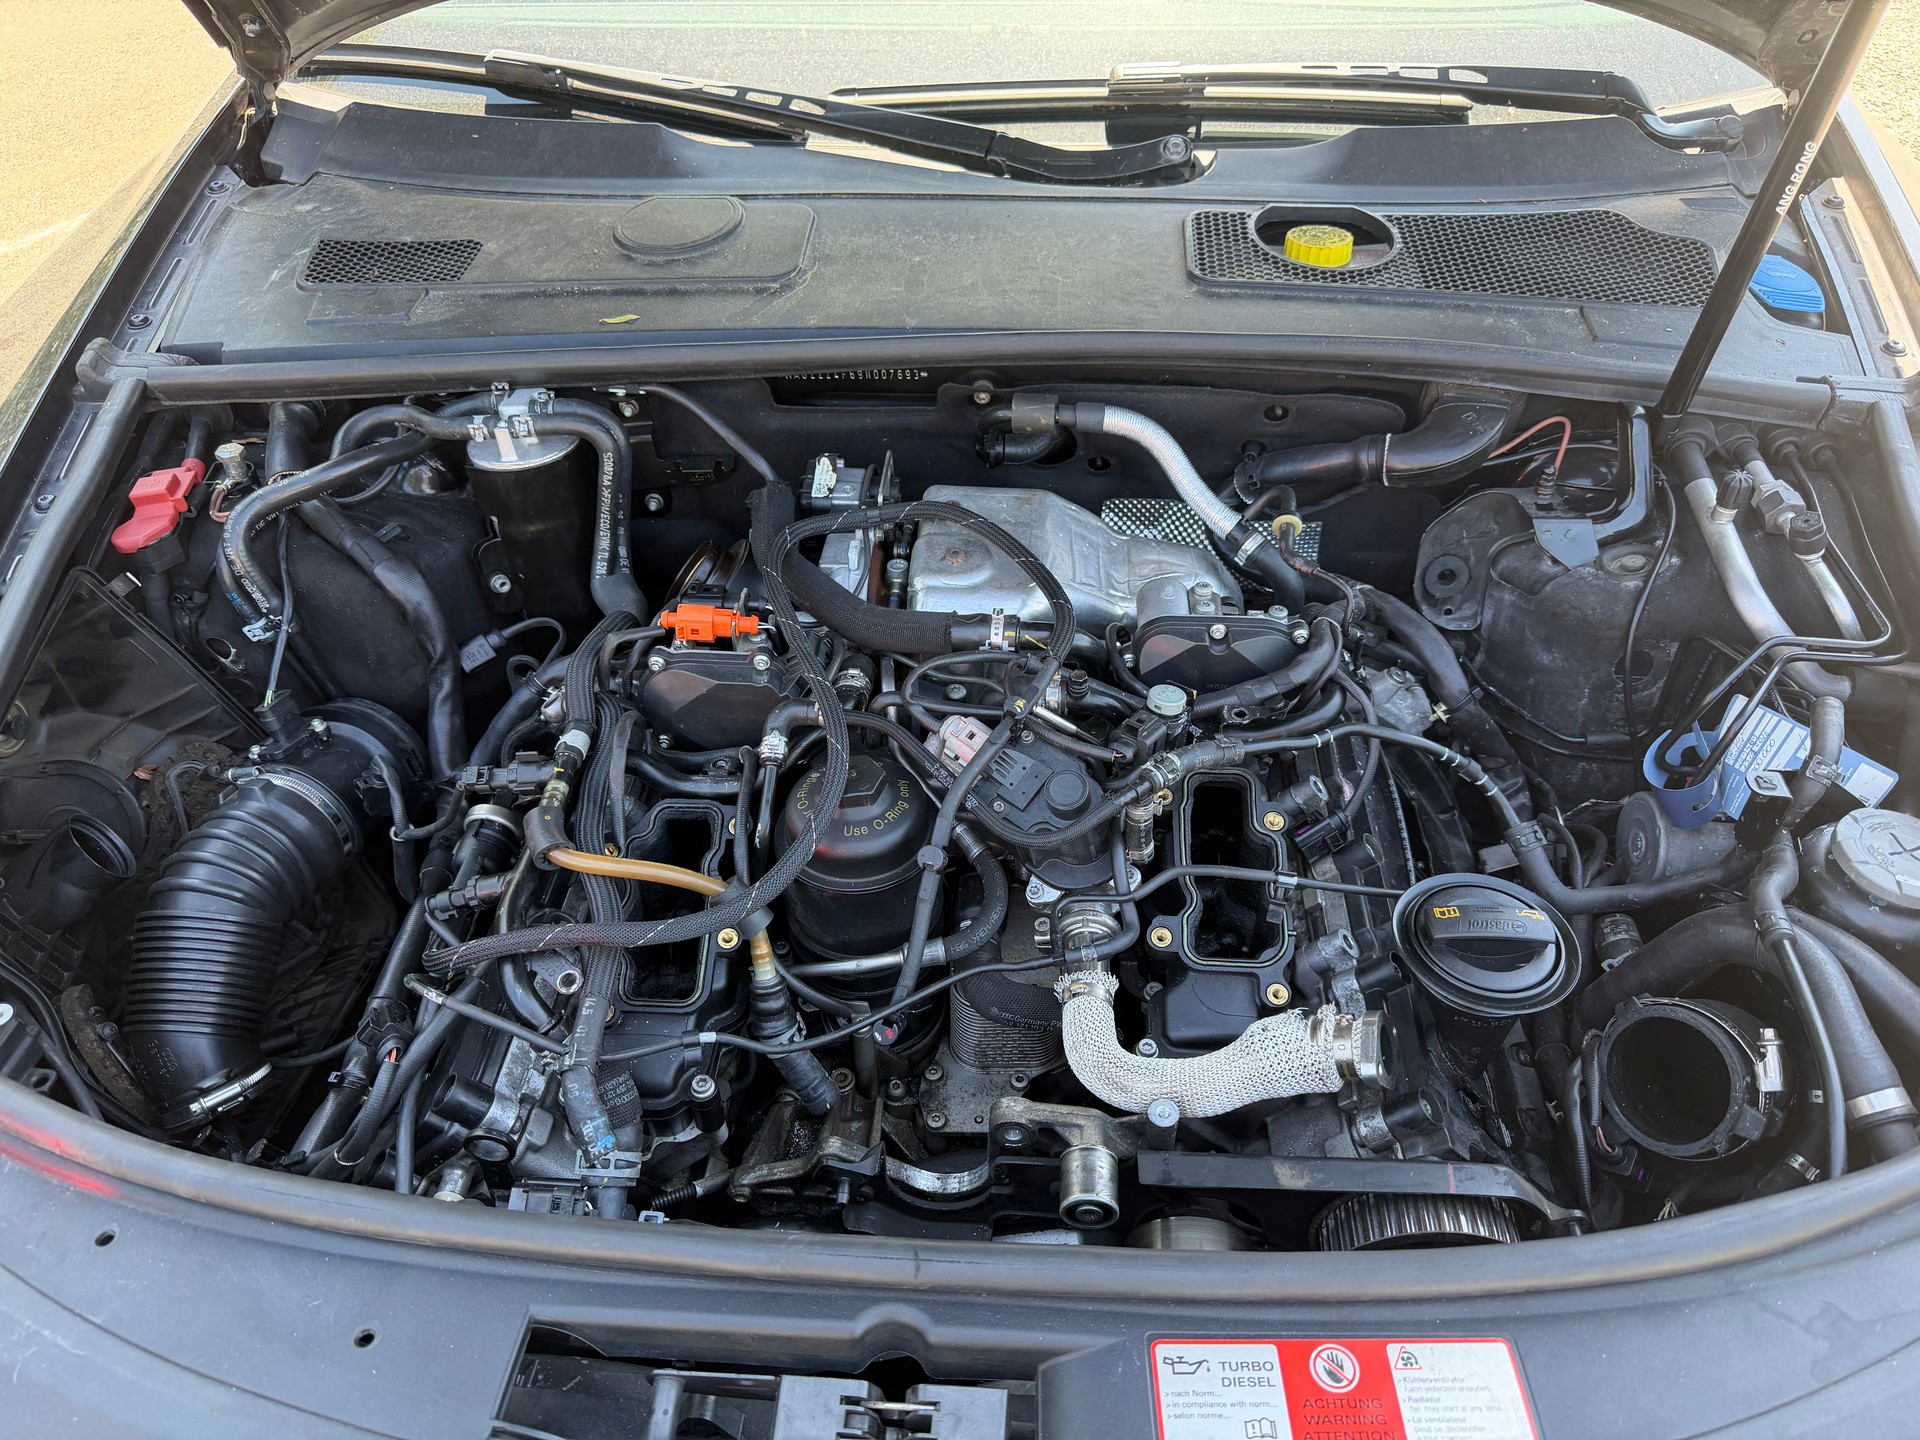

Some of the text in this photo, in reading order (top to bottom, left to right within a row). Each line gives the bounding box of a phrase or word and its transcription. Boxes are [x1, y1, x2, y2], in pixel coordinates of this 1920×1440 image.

[1790, 141, 1817, 183] RONG
[797, 772, 821, 810] O-Ringe
[843, 779, 910, 837] Use O-Ring only
[1467, 917, 1511, 931] Castrol
[1217, 1361, 1274, 1372] TURBO
[1221, 1377, 1276, 1388] DIESEL
[1402, 1375, 1466, 1384] Kühlerventilator
[1424, 1384, 1456, 1393] jederzeit
[1302, 1398, 1383, 1409] ACHTUNG
[1407, 1395, 1441, 1403] Radiator
[1181, 1401, 1228, 1409] compliance
[1409, 1404, 1421, 1412] fan
[1423, 1406, 1440, 1414] may
[1470, 1406, 1483, 1414] any
[1303, 1414, 1387, 1426] WARNING
[1412, 1415, 1467, 1424] Le ventilateur
[1303, 1430, 1396, 1440] ATTENTION
[1414, 1426, 1432, 1434] peut
